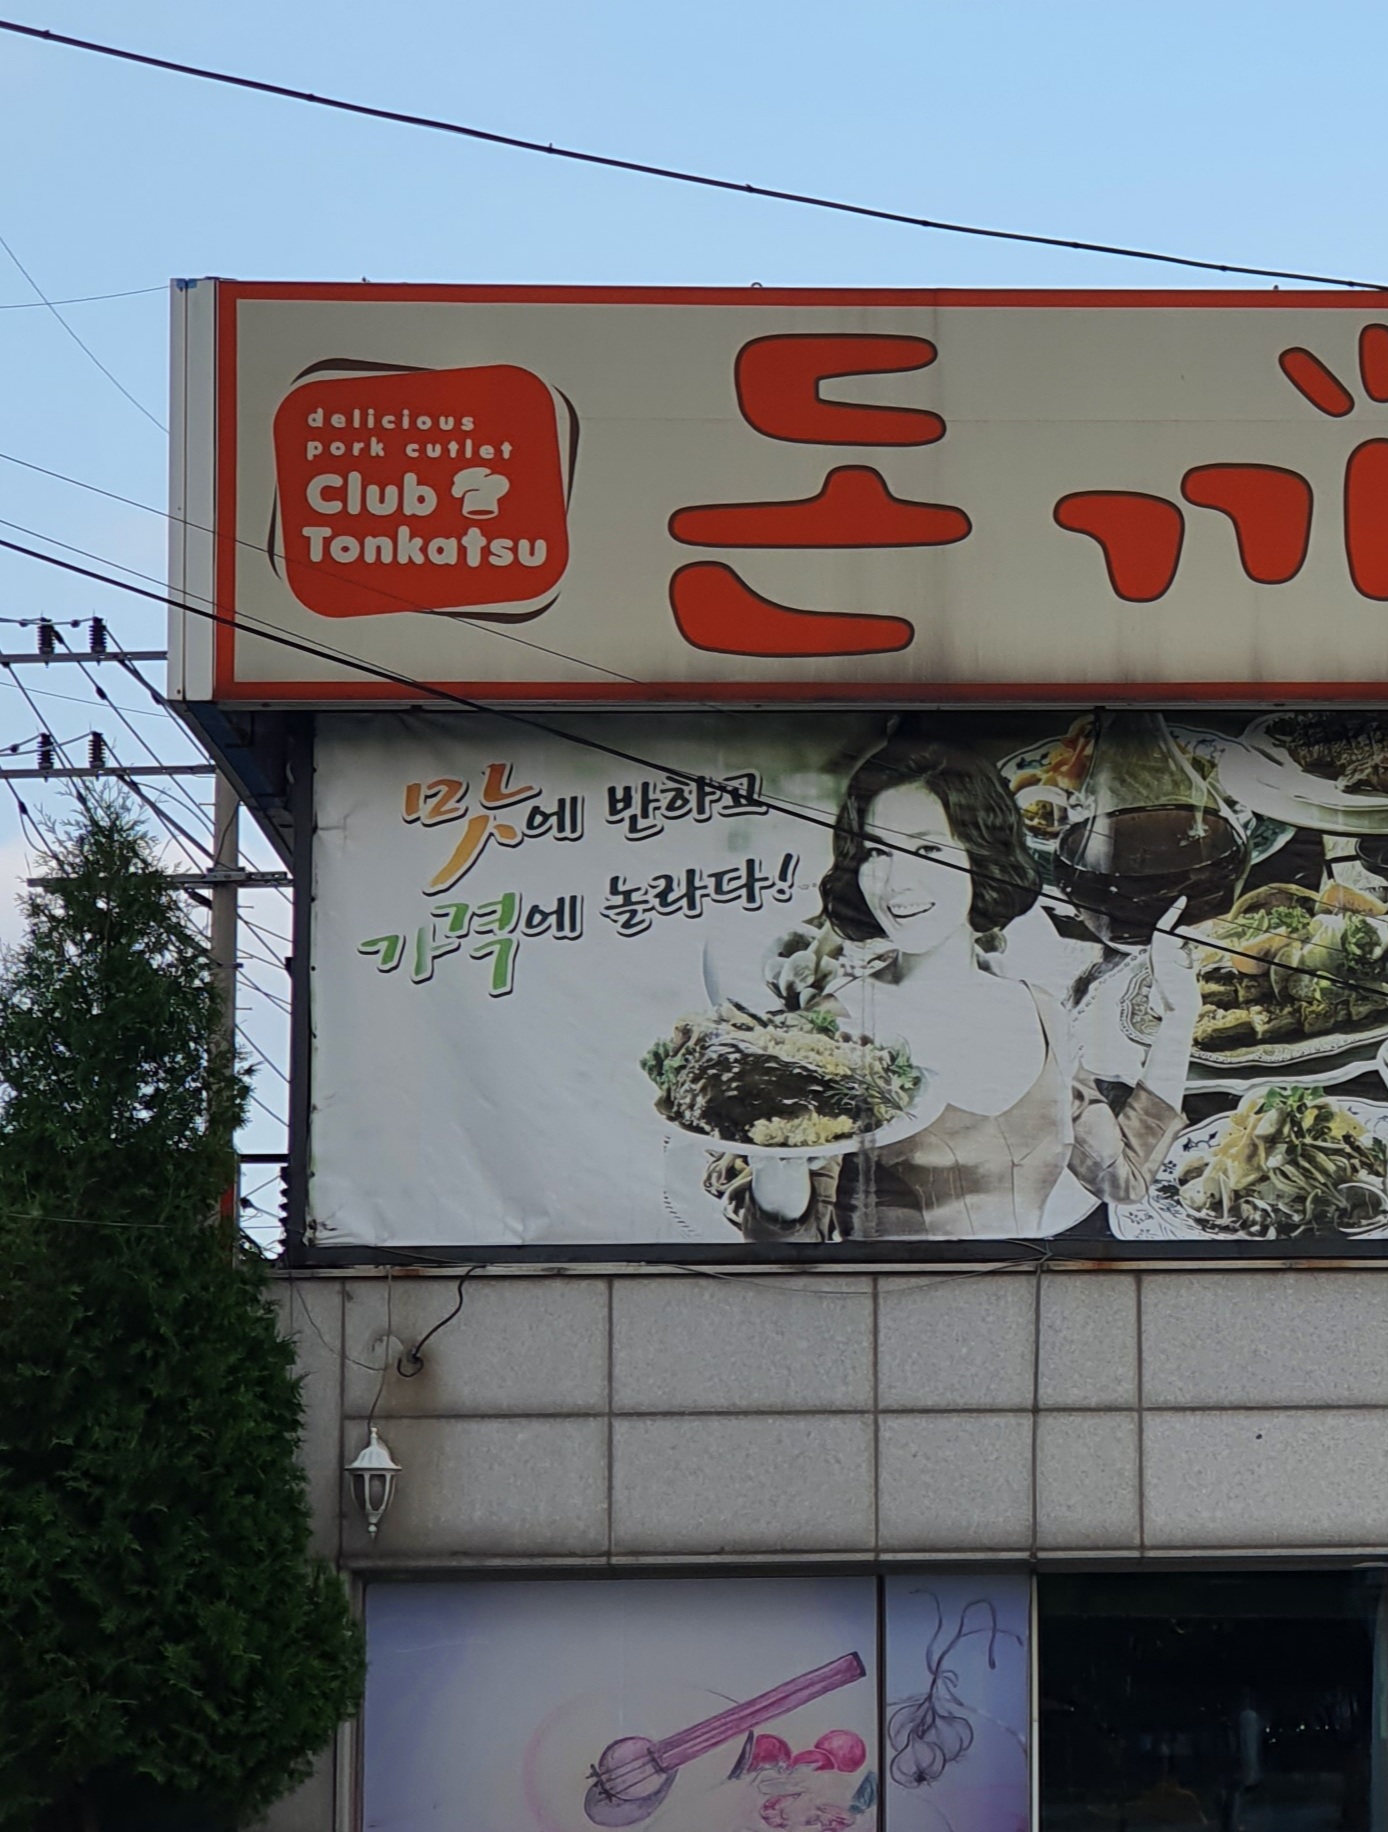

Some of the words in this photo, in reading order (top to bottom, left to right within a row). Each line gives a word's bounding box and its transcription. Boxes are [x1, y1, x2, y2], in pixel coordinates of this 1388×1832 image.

[306, 407, 475, 431] delicious
[306, 436, 385, 461] pork
[405, 438, 513, 459] cutlet
[306, 471, 437, 516] Club
[302, 525, 547, 567] Tonkatsu
[402, 763, 584, 895] 맛에
[605, 769, 773, 840] 반하고
[357, 892, 584, 997] 가격에
[601, 853, 799, 937] 놀라다!
